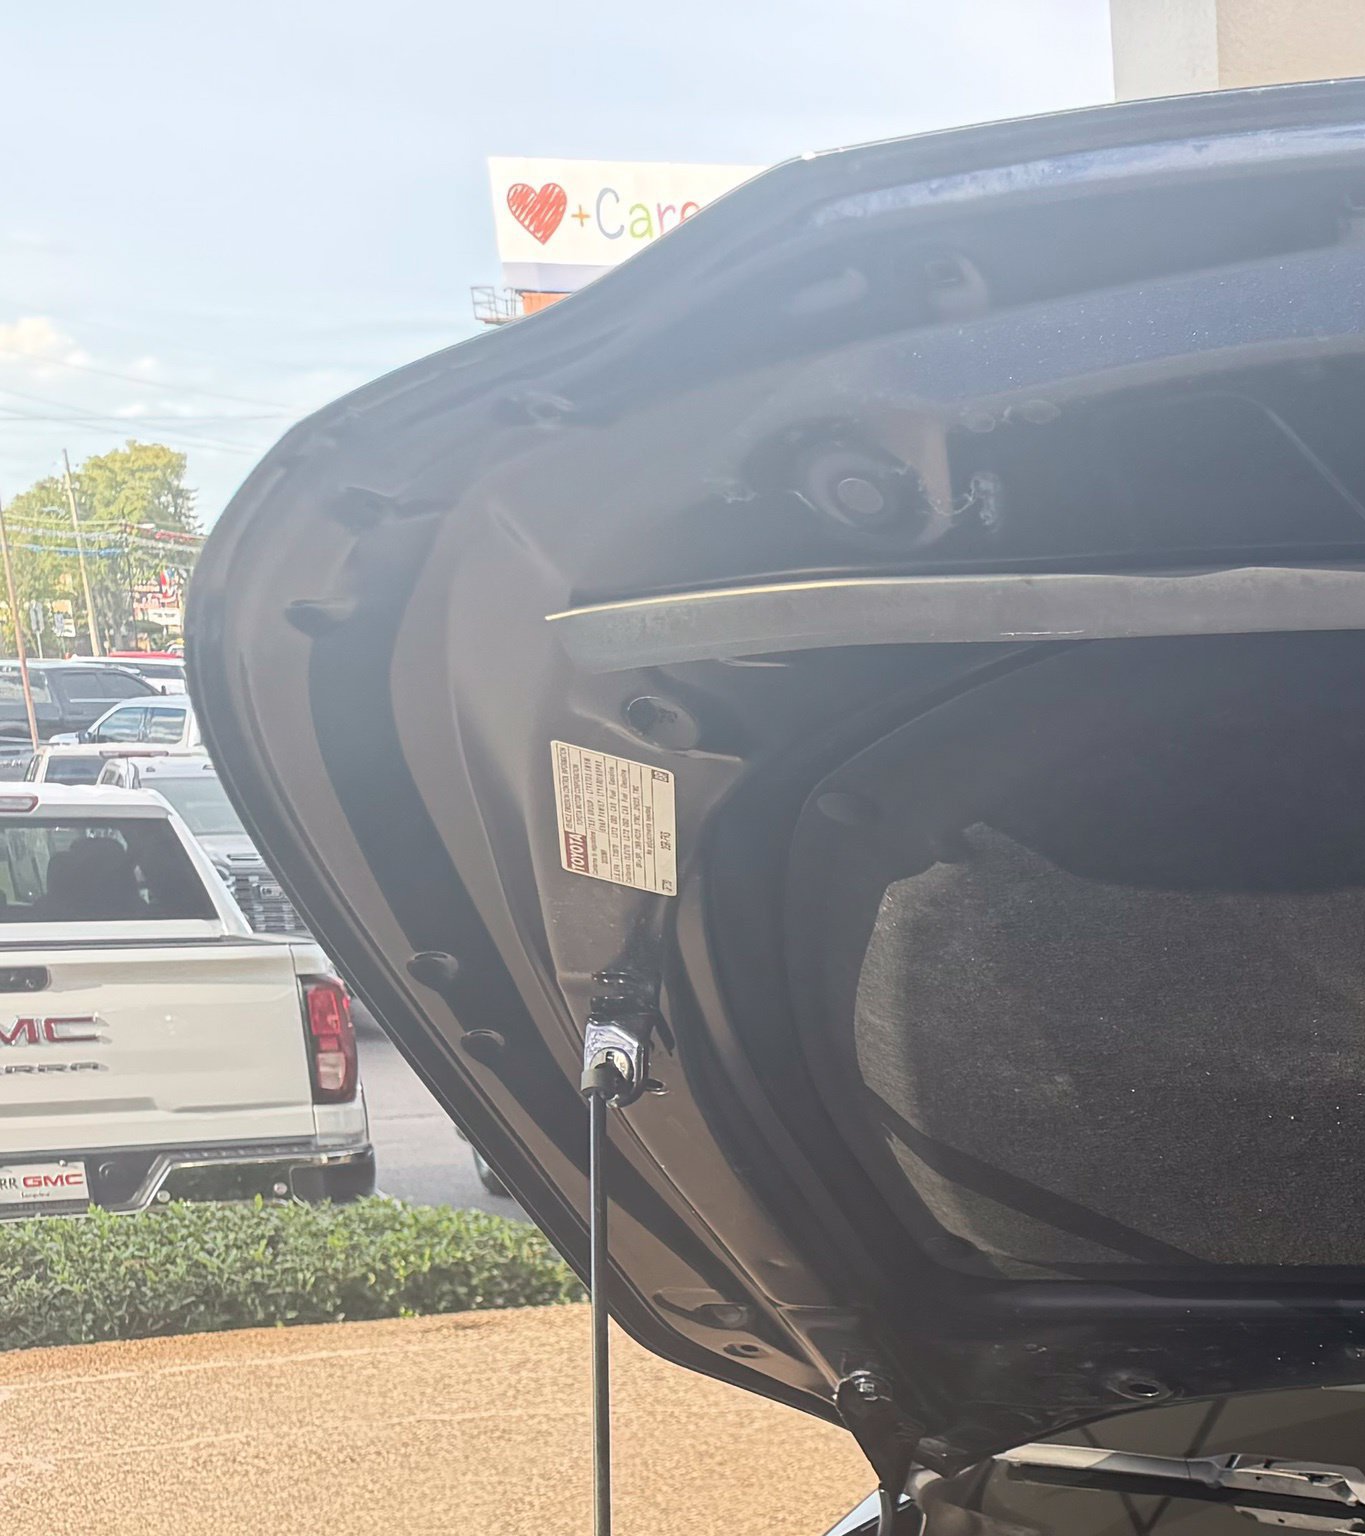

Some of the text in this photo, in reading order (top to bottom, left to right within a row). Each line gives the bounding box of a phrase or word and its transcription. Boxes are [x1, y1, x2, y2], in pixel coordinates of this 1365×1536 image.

[567, 832, 586, 872] TOYOTA
[0, 1014, 101, 1045] MC
[23, 1173, 84, 1188] GMC
